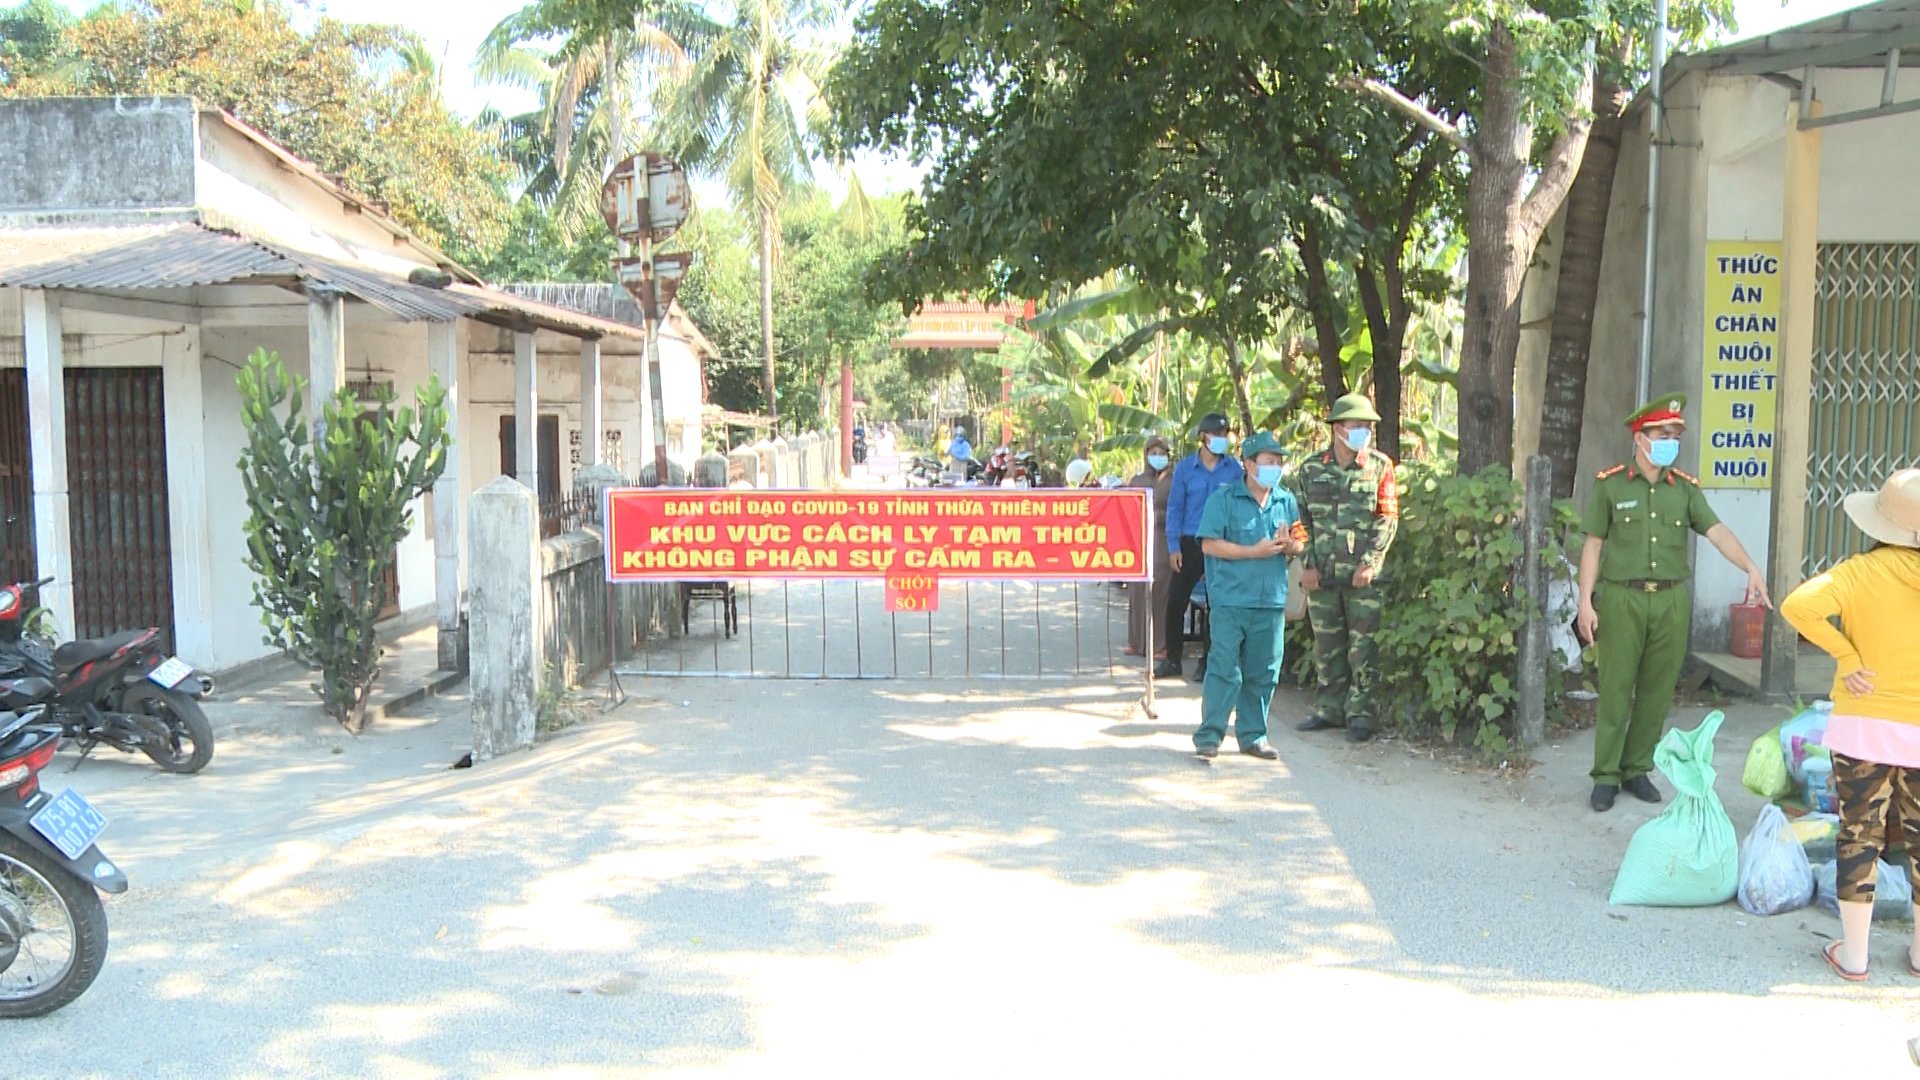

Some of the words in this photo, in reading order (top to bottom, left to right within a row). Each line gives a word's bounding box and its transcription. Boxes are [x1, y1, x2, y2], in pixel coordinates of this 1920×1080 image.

[1716, 253, 1778, 274] THỨC
[1731, 283, 1762, 303] ĂN
[1715, 313, 1776, 332] CHĂN
[1718, 341, 1772, 361] NUÔI
[1711, 368, 1777, 390] THIẾT
[1732, 403, 1754, 423] BỊ
[1711, 429, 1772, 448] CHĂN
[1714, 457, 1767, 477] NUÔI
[664, 501, 704, 517] BAN
[709, 496, 742, 515] CHỈ
[747, 500, 786, 518] ĐẠO
[792, 500, 880, 516] COVID-19
[884, 497, 929, 516] TỈNH
[935, 498, 985, 516] THỪA
[990, 498, 1047, 516] THIÊN
[1052, 497, 1091, 516] HUẾ
[650, 525, 716, 544] KHU
[727, 523, 791, 546] VỰC
[803, 521, 893, 543] CÁCH
[903, 525, 939, 544] LY
[949, 525, 1022, 547] TẠM
[1033, 521, 1107, 544] THỜI
[623, 547, 735, 568] KHÔNG
[746, 545, 838, 570] PHẬN
[849, 548, 898, 570] SỰ
[905, 543, 982, 568] CẤM
[992, 549, 1036, 568] RA
[1070, 544, 1136, 568] VÀO
[888, 573, 935, 590] CHỐT
